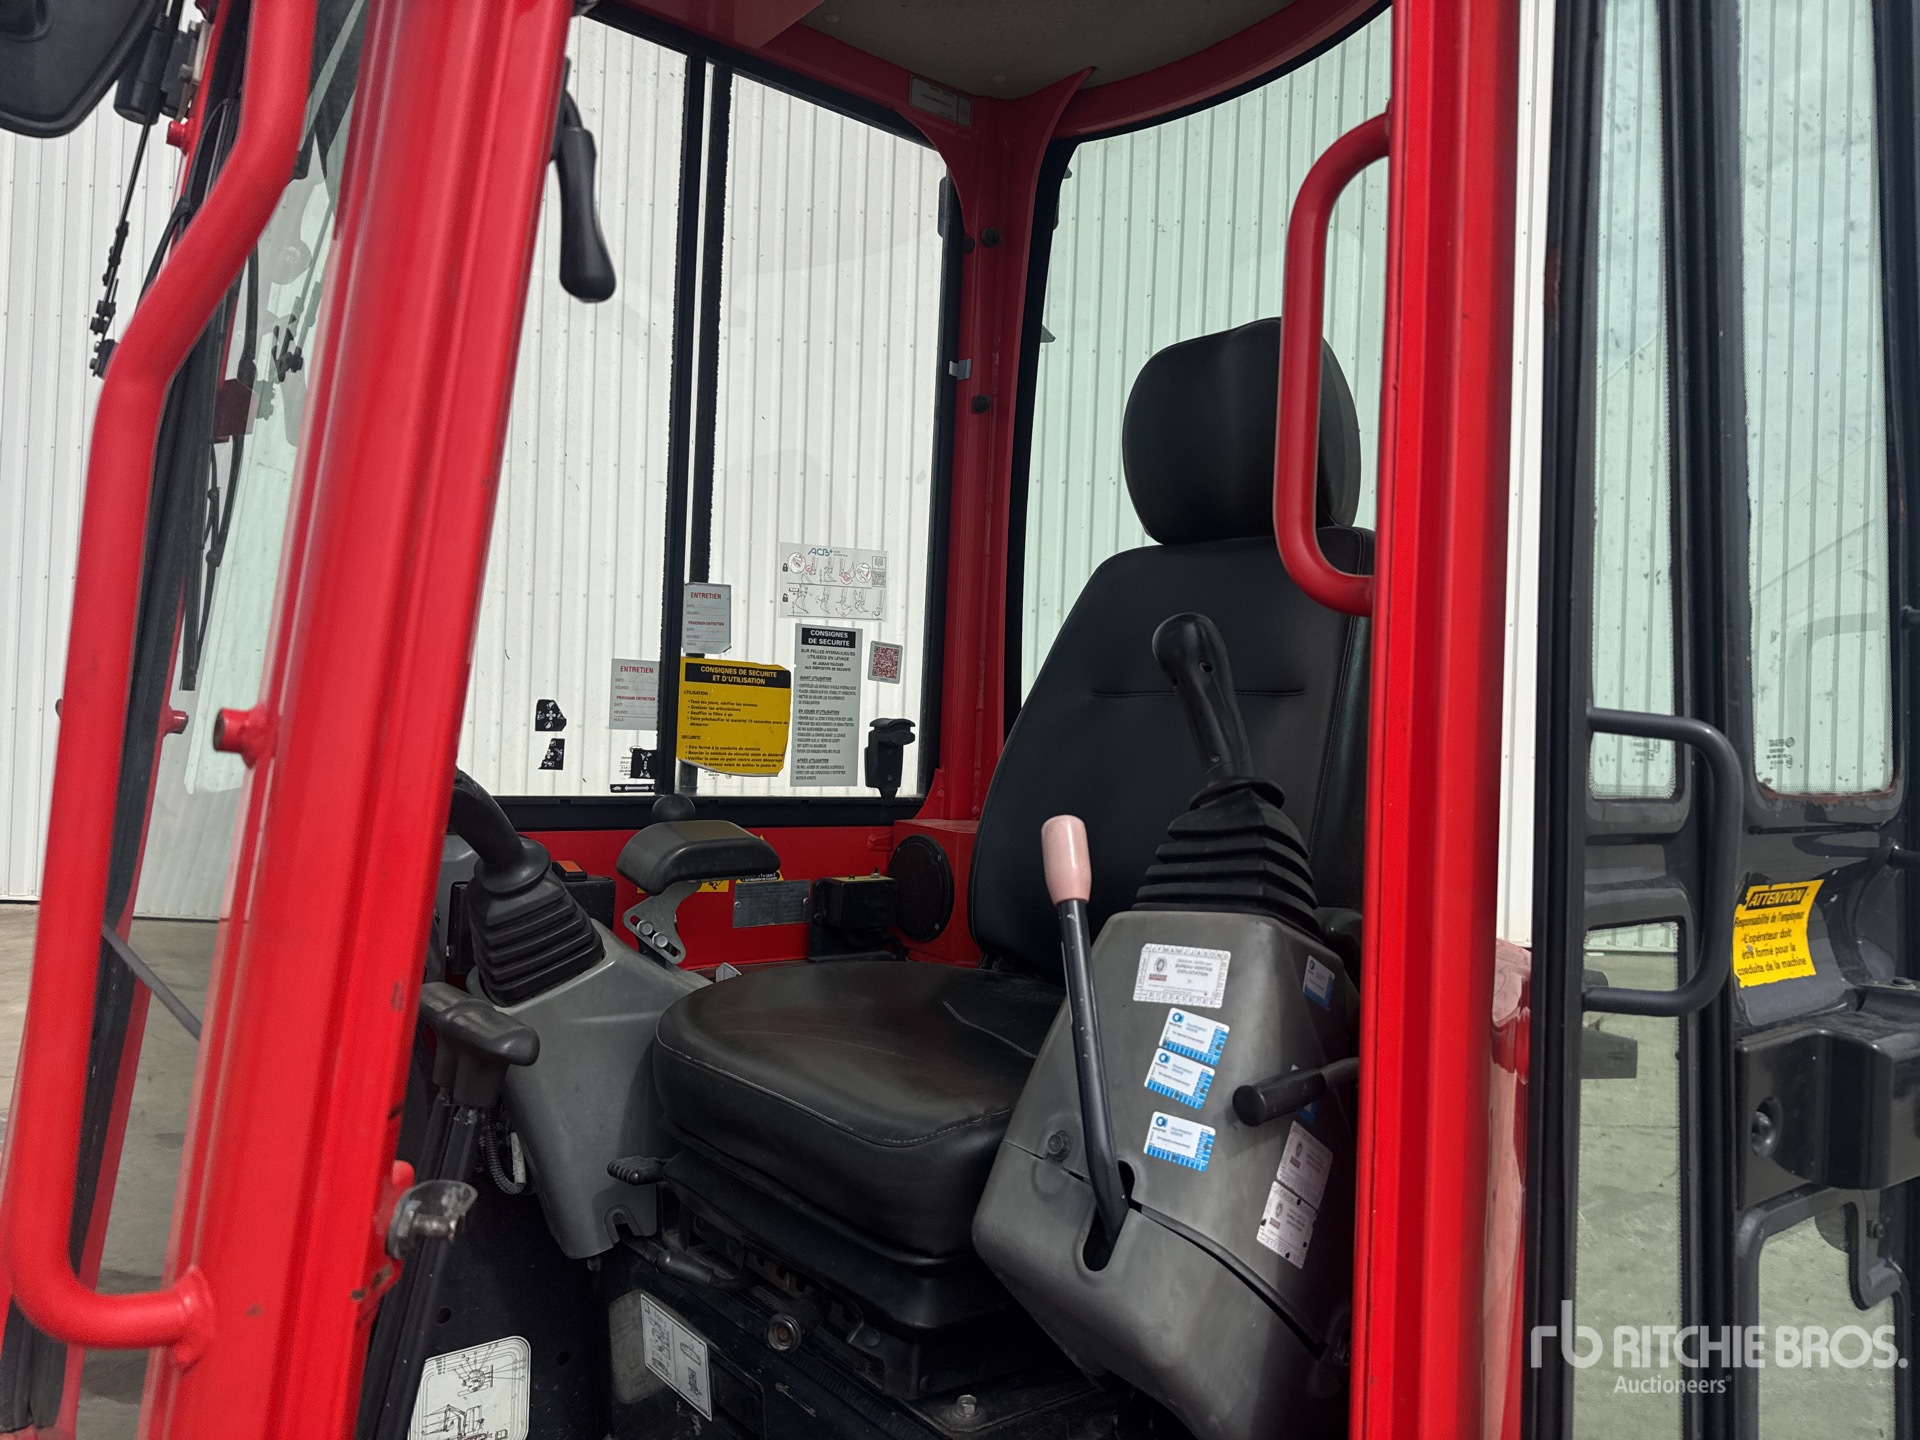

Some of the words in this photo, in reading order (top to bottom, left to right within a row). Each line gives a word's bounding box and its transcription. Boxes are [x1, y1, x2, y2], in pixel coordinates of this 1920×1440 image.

[810, 630, 848, 638] CONSIGNES
[700, 666, 737, 675] CONSIGNES
[749, 670, 777, 678] SECURITE
[722, 676, 765, 685] D'UTILISATION
[1748, 889, 1805, 906] ATTENTION
[1780, 928, 1792, 938] doit
[1755, 947, 1774, 956] formé
[1775, 946, 1789, 956] pour
[1790, 943, 1796, 951] la
[1737, 965, 1764, 975] conduite
[1765, 962, 1774, 971] de
[1775, 960, 1781, 969] la
[1782, 957, 1806, 968] machine
